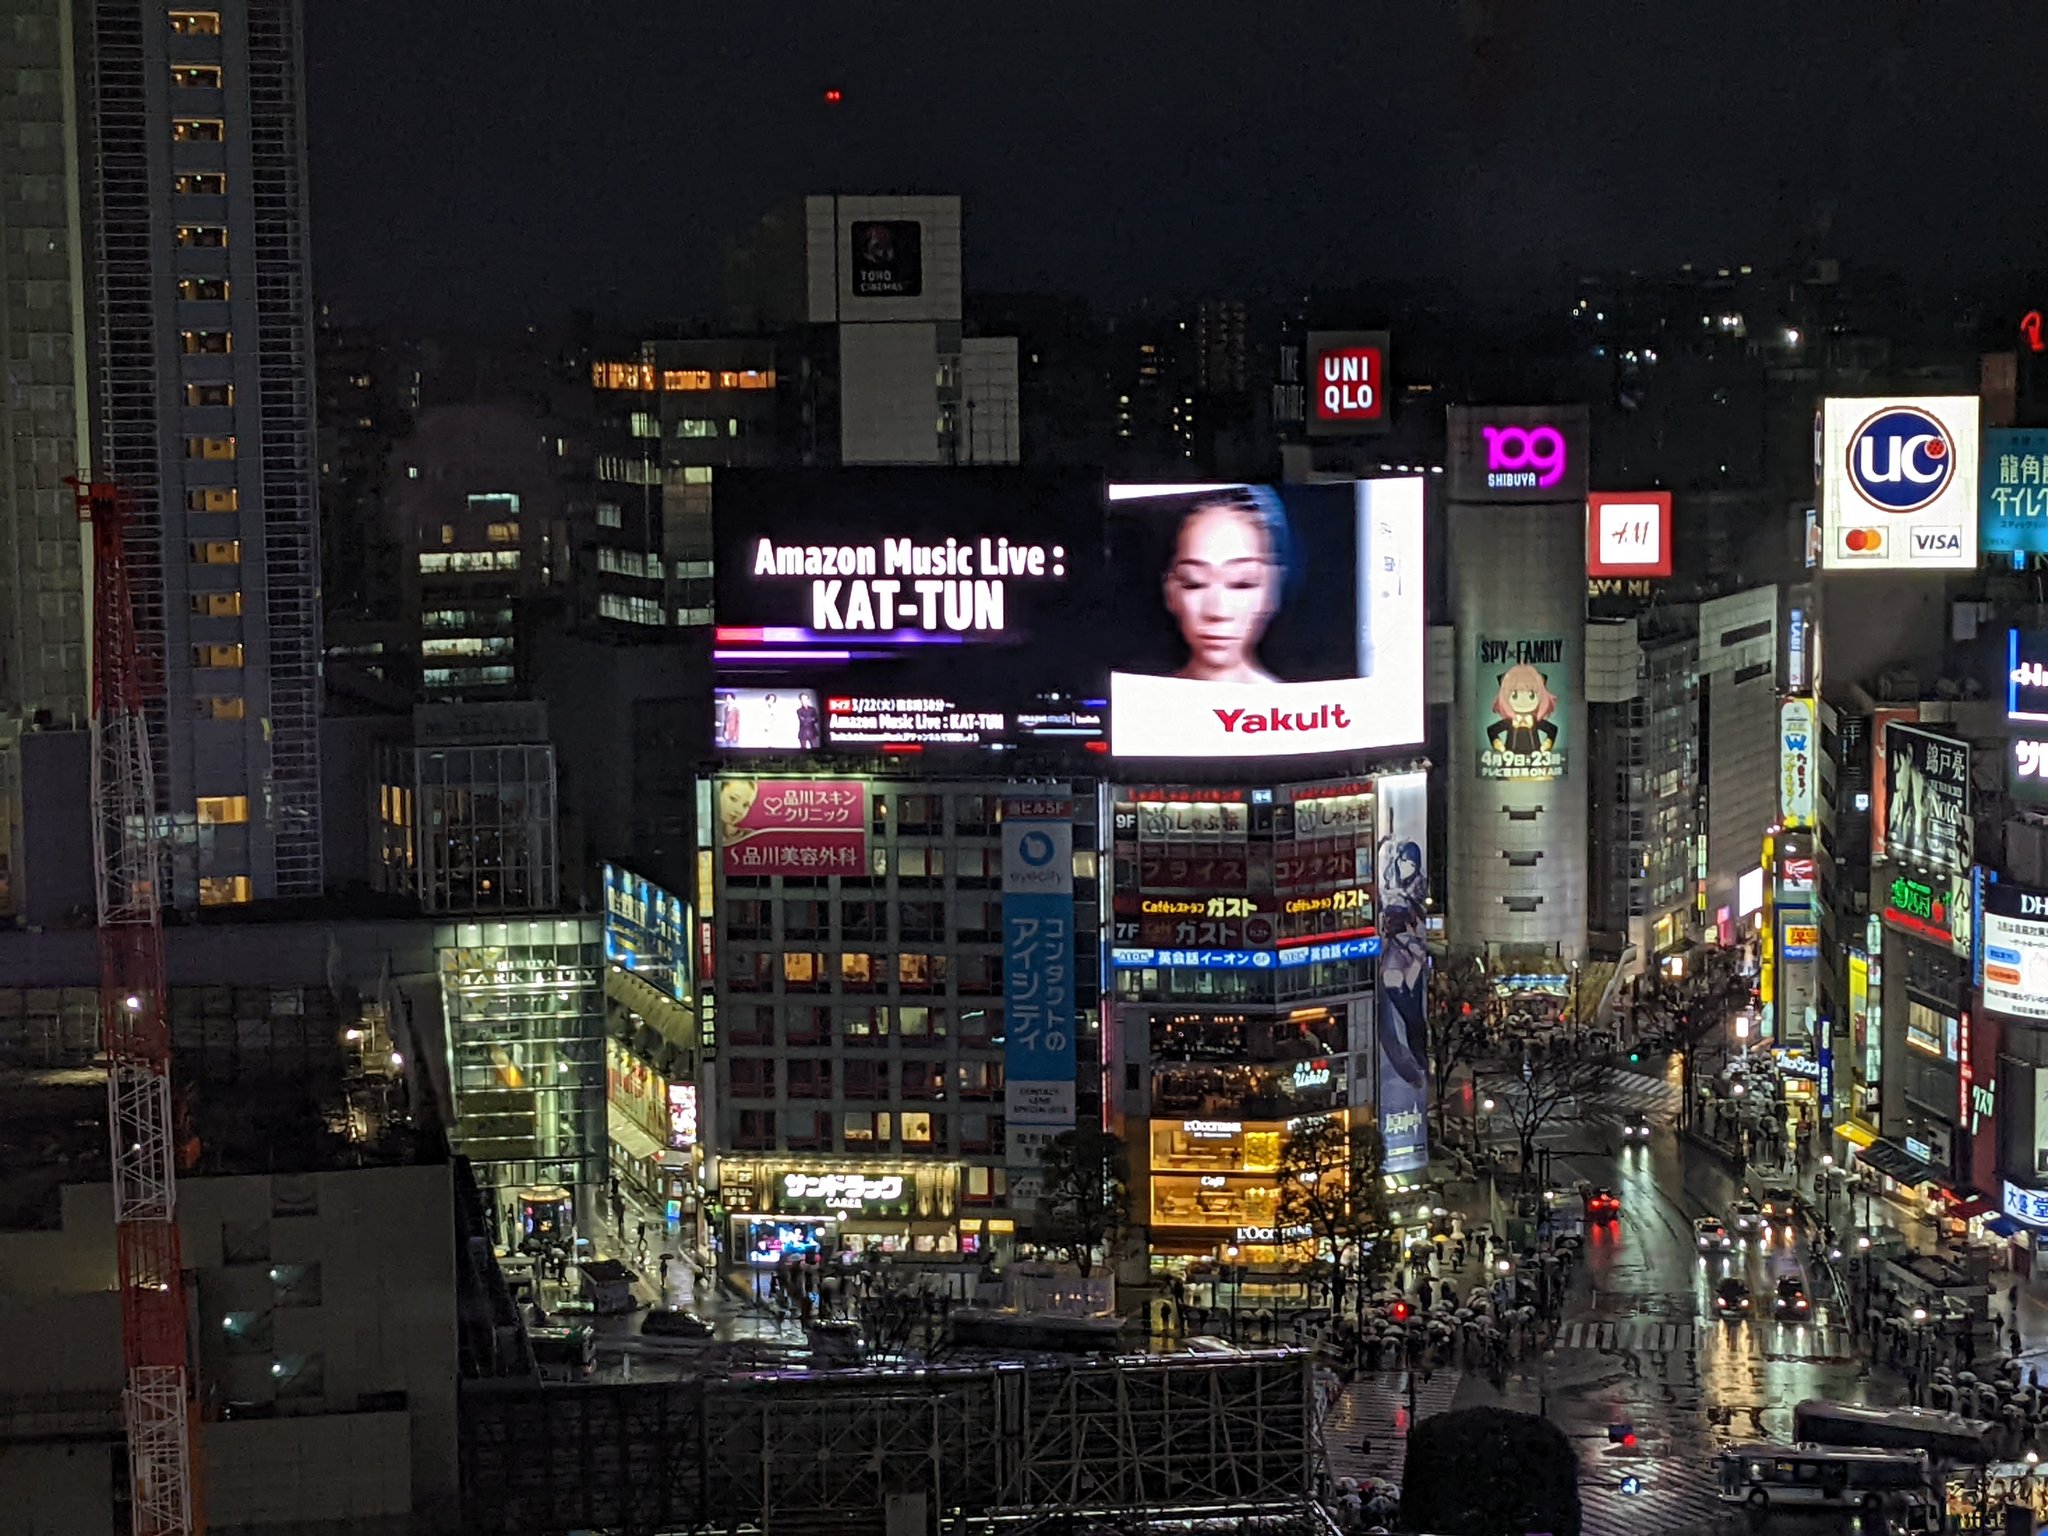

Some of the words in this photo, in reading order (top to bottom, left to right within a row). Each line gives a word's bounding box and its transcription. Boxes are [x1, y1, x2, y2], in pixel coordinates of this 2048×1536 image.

[861, 270, 892, 281] TOHO
[861, 283, 904, 292] CINEMAS
[1325, 357, 1368, 381] UNI
[1325, 385, 1372, 413] QLO
[1483, 427, 1566, 489] 109
[1860, 434, 1944, 484] UC
[1488, 473, 1536, 487] SHIBUYA
[1915, 535, 1960, 550] VISA
[755, 538, 876, 575] Amazon
[884, 537, 973, 575] Music
[981, 537, 1046, 575] Live
[812, 580, 1004, 630] KAT-TUN
[829, 714, 877, 729] Amazon
[879, 713, 913, 729] Music
[950, 713, 1004, 729] KAT-TUN
[1212, 703, 1351, 734] Yakult
[783, 789, 856, 806] 品川スキン
[784, 808, 849, 822] クリニック
[1116, 814, 1135, 829] 9F
[742, 846, 857, 866] 品川美容外科
[1207, 897, 1258, 917] ガスト
[1333, 888, 1370, 911] ガスト
[1116, 922, 1140, 939] 7F
[1176, 920, 1238, 946] ガスト
[1158, 951, 1249, 966] 英会話イーオン
[1310, 940, 1378, 962] 英会話イーオン
[487, 960, 555, 971] SHIBUYA
[451, 973, 524, 986] MARK
[534, 970, 595, 985] CITY
[1011, 918, 1040, 1051] アイシティ
[784, 1173, 904, 1199] サンドラッグ
